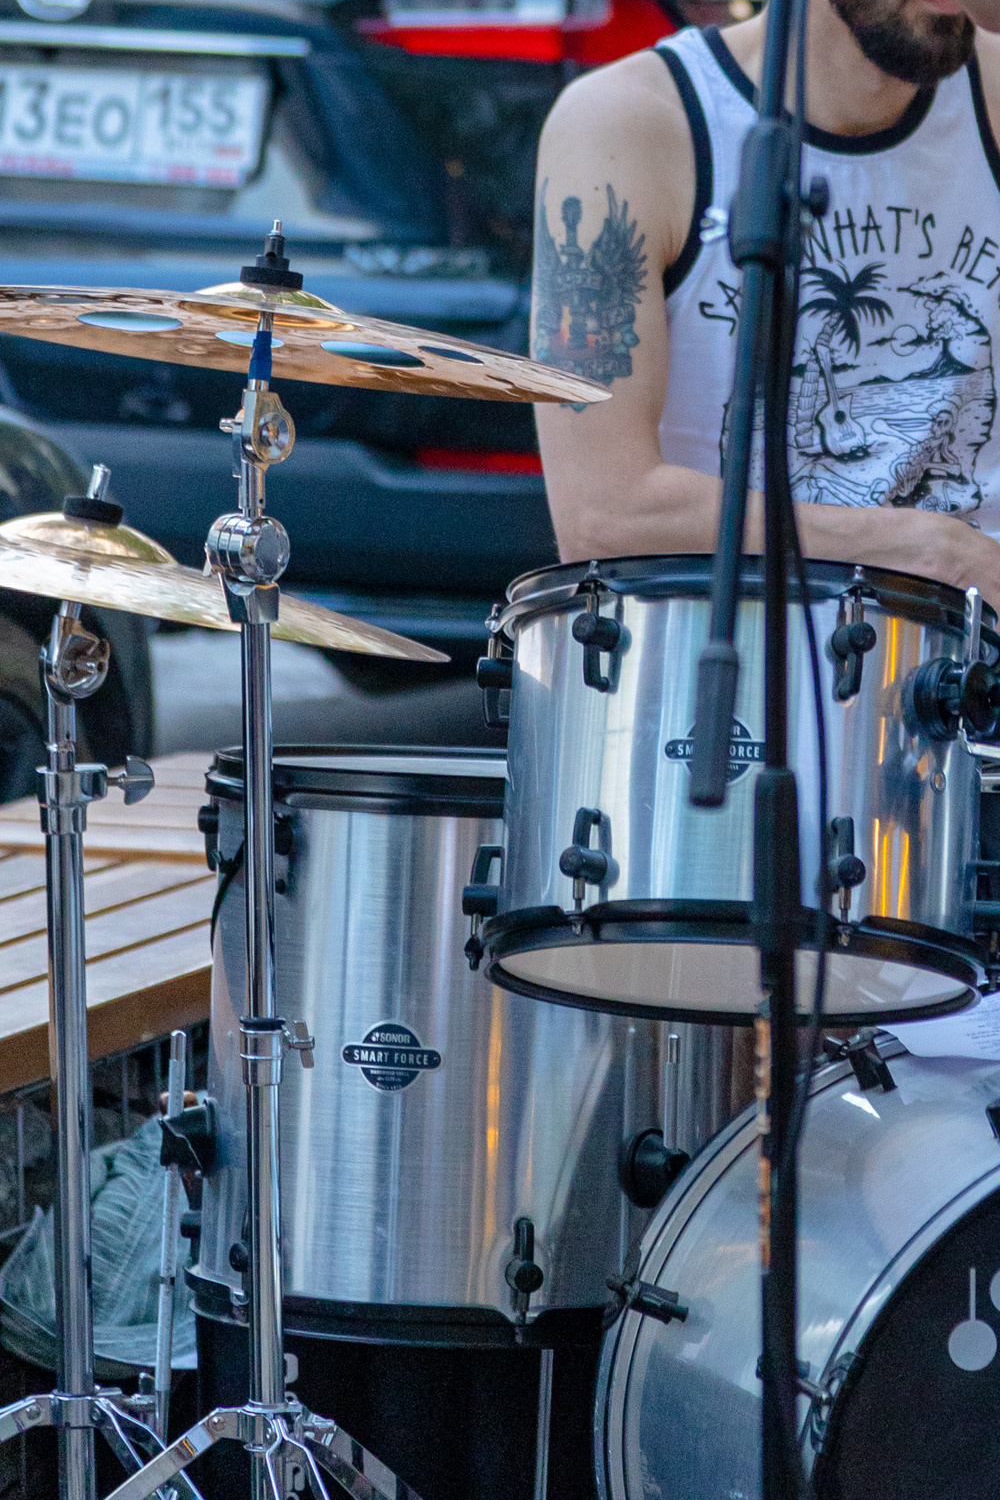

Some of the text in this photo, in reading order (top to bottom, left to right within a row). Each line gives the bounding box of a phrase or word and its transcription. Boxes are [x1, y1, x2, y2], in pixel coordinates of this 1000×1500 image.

[0, 77, 132, 147] 3EO
[698, 279, 745, 337] SA
[728, 744, 760, 759] ORCE
[380, 1031, 411, 1044] SONOR
[353, 1049, 429, 1066] SMART FORCE
